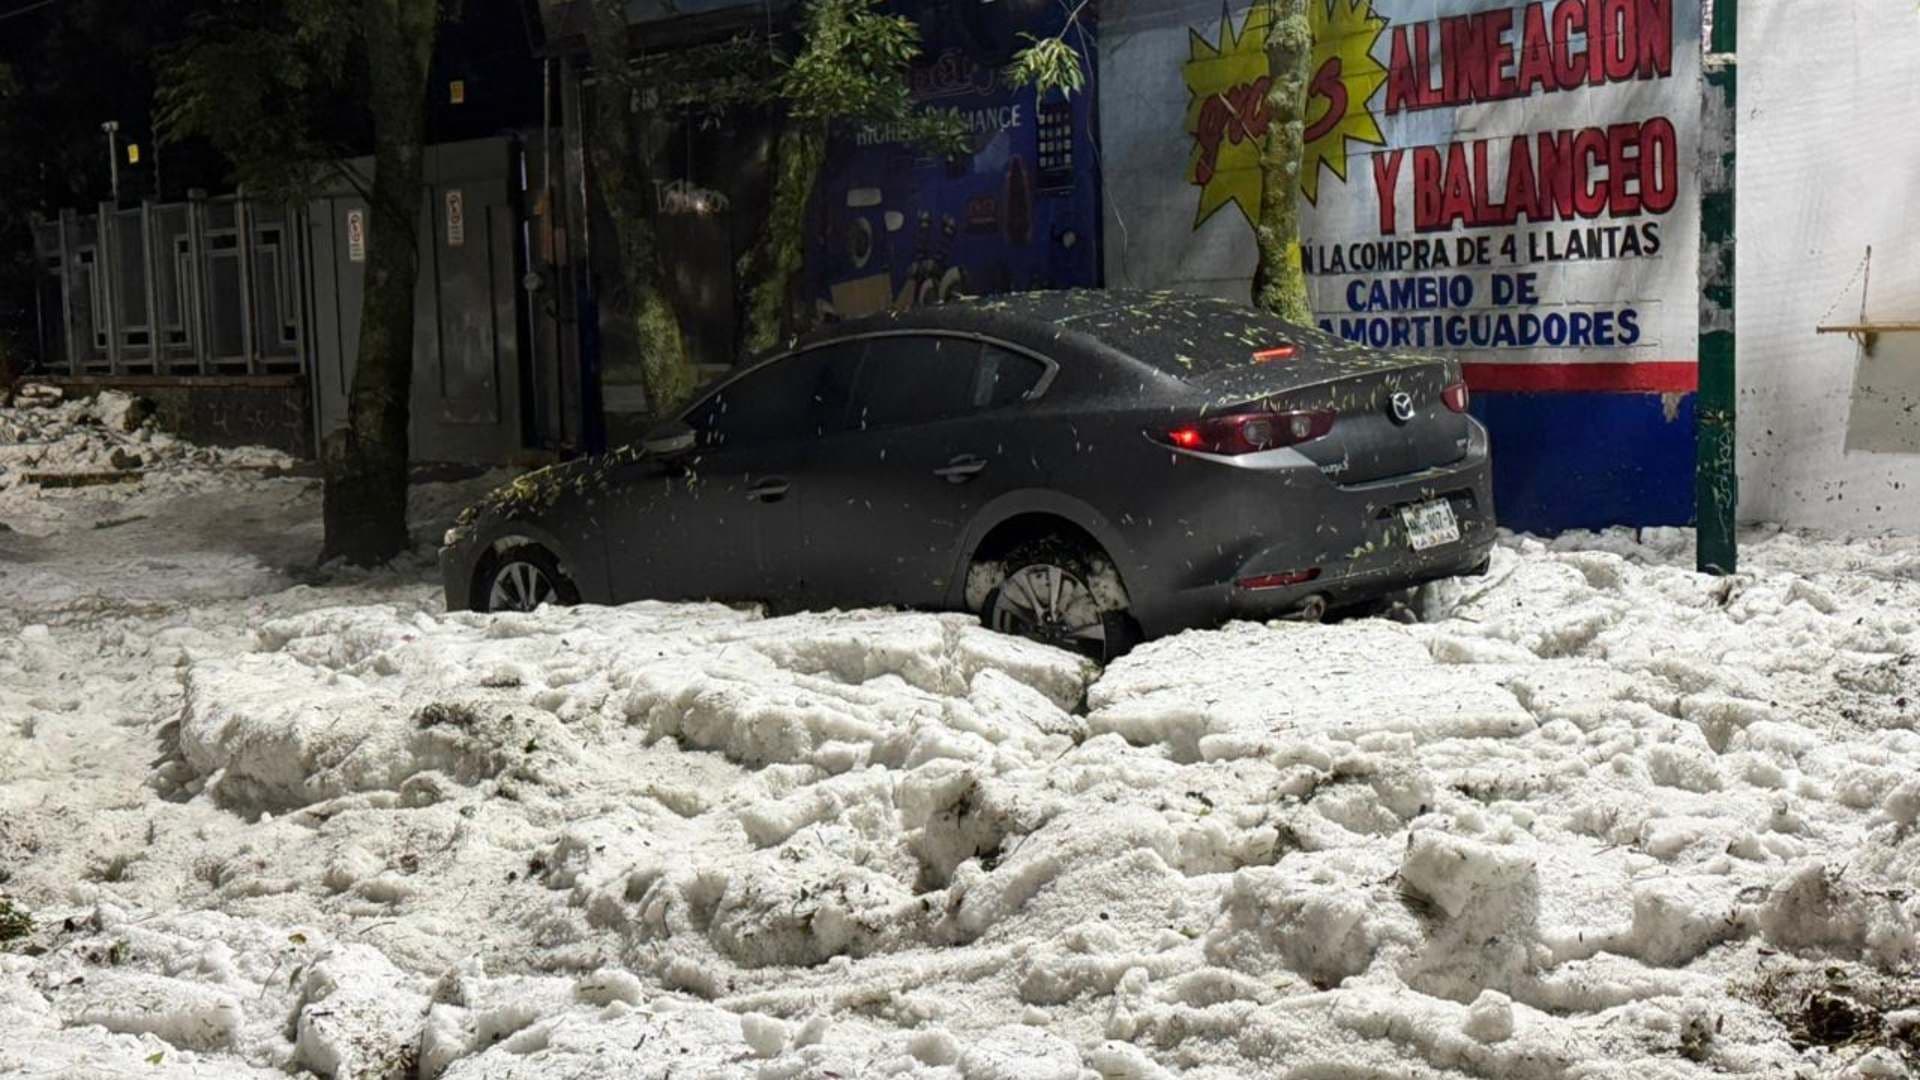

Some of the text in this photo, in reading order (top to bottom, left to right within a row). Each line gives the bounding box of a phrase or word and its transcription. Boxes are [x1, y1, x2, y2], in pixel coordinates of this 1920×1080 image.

[1385, 0, 1673, 116] ALINEACION
[1372, 116, 1679, 236] Y BALANCEO
[1319, 243, 1347, 274] LA
[1349, 237, 1451, 271] COMPRA
[1456, 234, 1492, 267] DE
[1500, 233, 1517, 263] 4
[1528, 221, 1662, 263] LLANTAS
[1346, 271, 1539, 313] CAMBIO DE
[1318, 307, 1641, 349] AMORTIGUADORES
